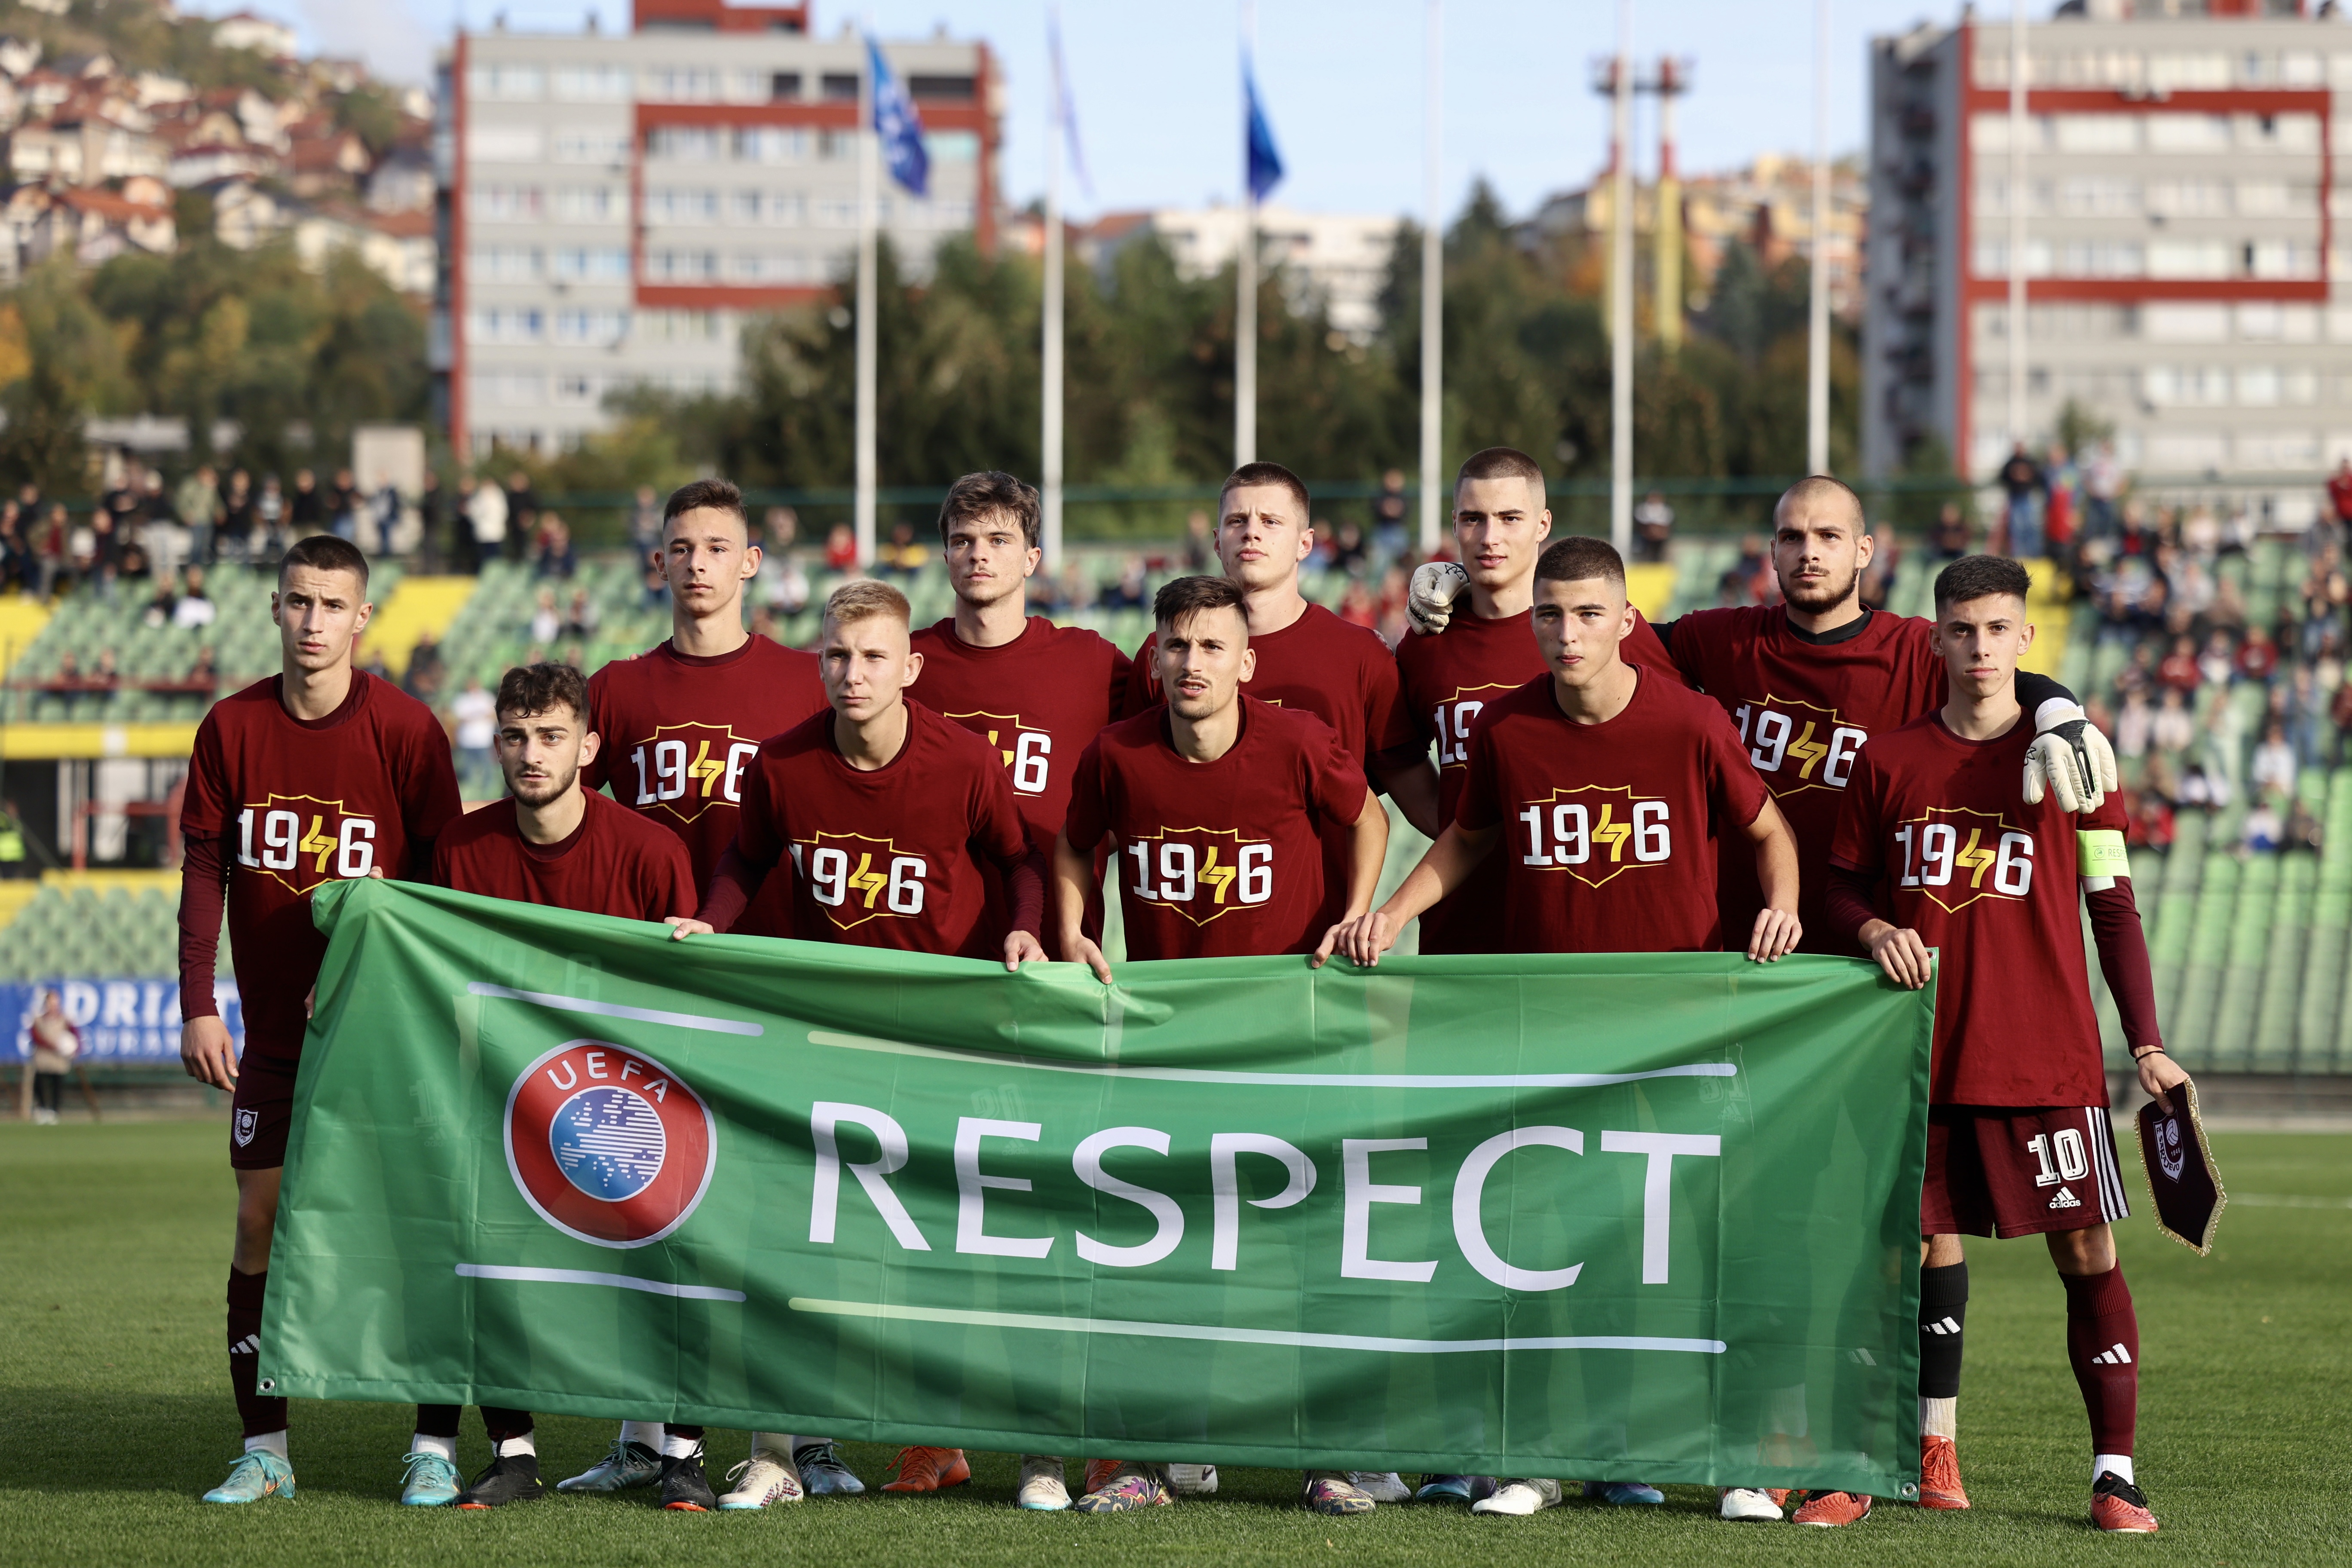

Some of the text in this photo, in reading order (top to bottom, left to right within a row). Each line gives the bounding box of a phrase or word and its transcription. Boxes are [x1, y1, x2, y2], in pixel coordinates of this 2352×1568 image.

[237, 808, 376, 877] 1946
[1520, 801, 1671, 865] 1946
[1895, 824, 2034, 896] 1946
[1129, 841, 1273, 904] 1946
[547, 1052, 668, 1104] UEFA
[2027, 1128, 2089, 1187] 10
[2156, 1125, 2162, 1134] FK
[2158, 1135, 2180, 1172] SARAJEVO
[2171, 1147, 2181, 1157] 1946
[808, 1101, 1721, 1292] RESPECT
[2049, 1199, 2081, 1209] adidas
